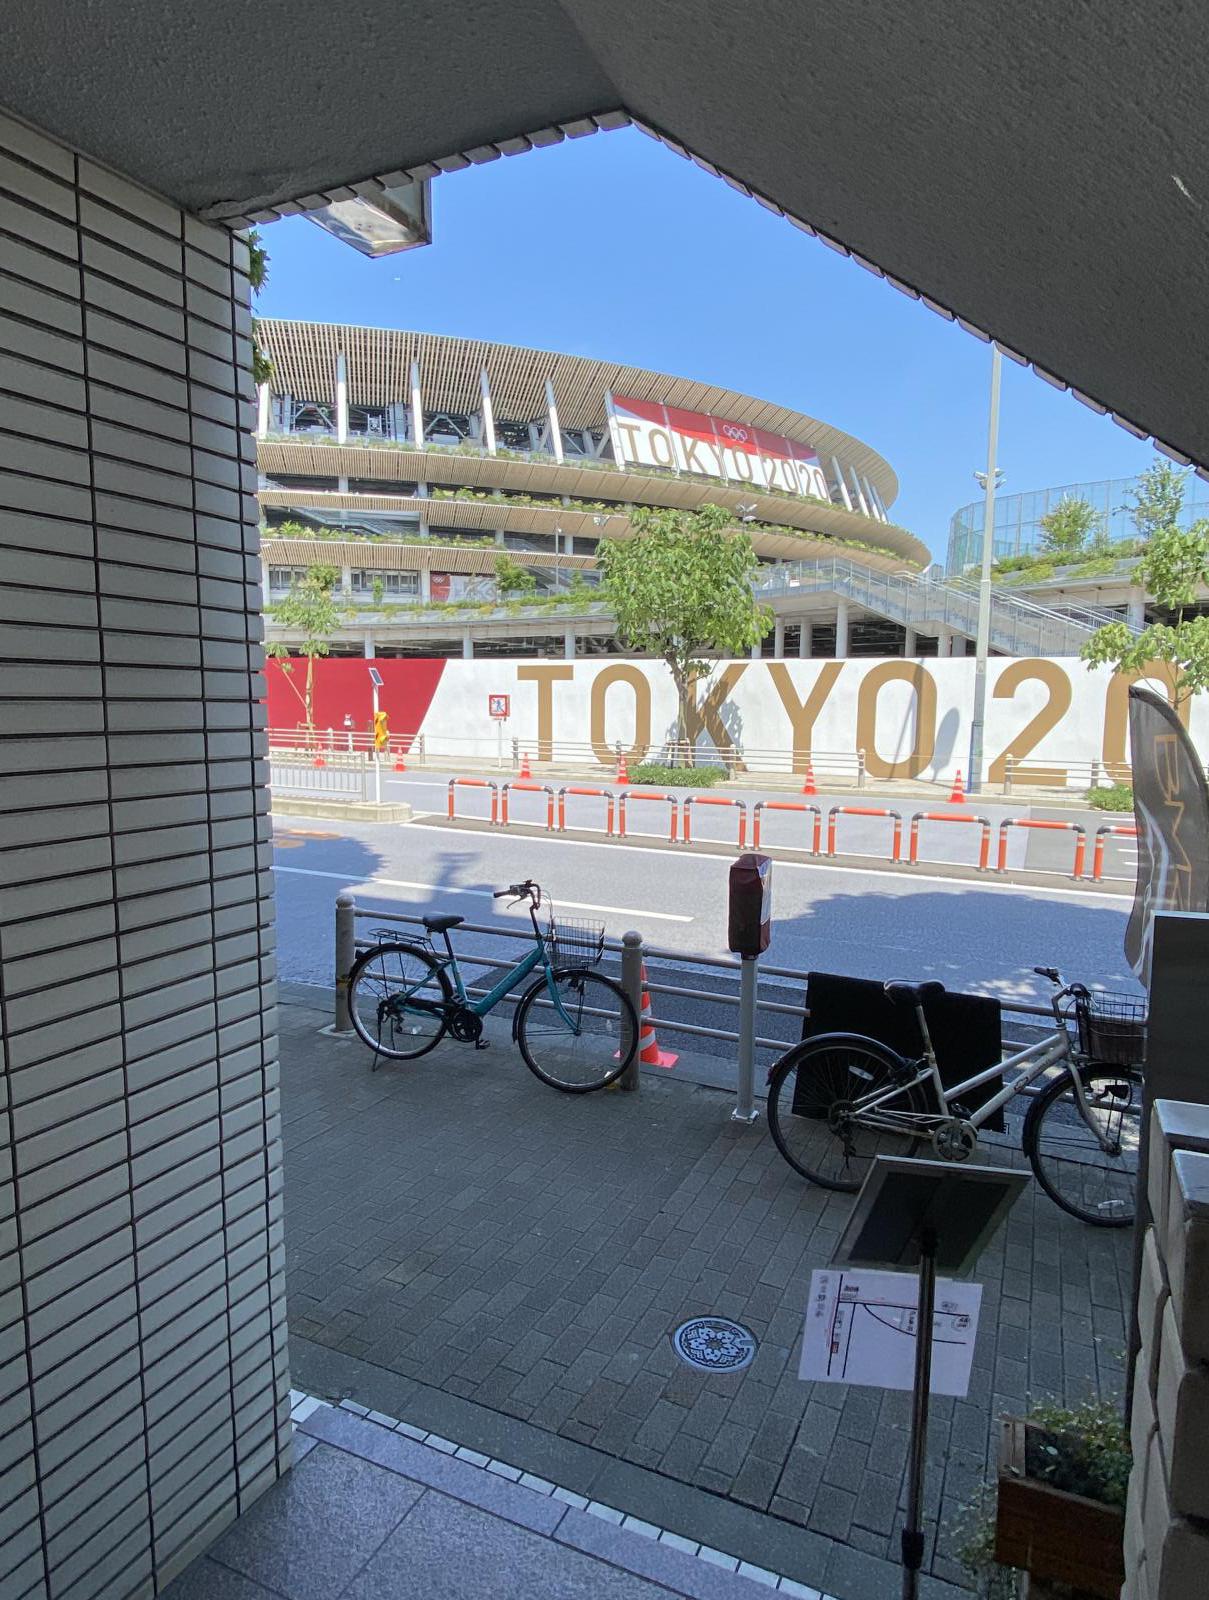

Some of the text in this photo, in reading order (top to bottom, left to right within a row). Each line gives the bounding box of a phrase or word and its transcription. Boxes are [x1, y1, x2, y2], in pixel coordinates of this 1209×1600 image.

[617, 422, 829, 500] TOKYO 2020
[517, 660, 937, 780] TOKYO
